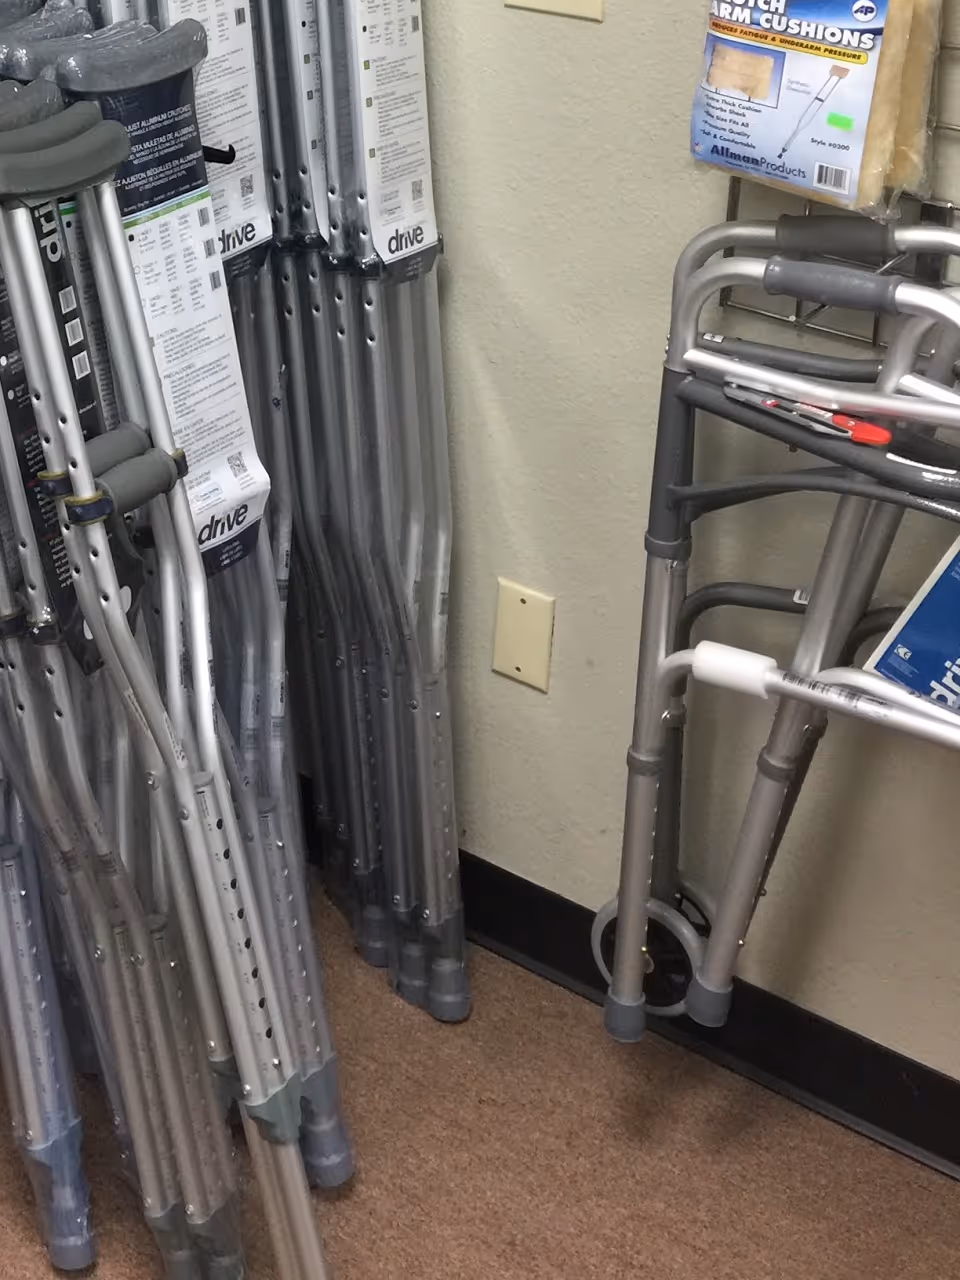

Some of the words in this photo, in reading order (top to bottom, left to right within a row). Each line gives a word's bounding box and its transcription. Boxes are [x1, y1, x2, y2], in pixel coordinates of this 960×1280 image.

[710, 0, 751, 25] ARM
[760, 13, 875, 50] CUSHIONS
[739, 27, 768, 40] FATIGUE
[779, 38, 821, 52] UNDERARM
[823, 47, 862, 61] PRESSURE
[721, 98, 736, 108] Thick
[811, 138, 826, 147] Style
[35, 203, 61, 262] dri
[388, 225, 424, 254] drive
[198, 504, 248, 546] drive
[929, 655, 960, 707] dri
